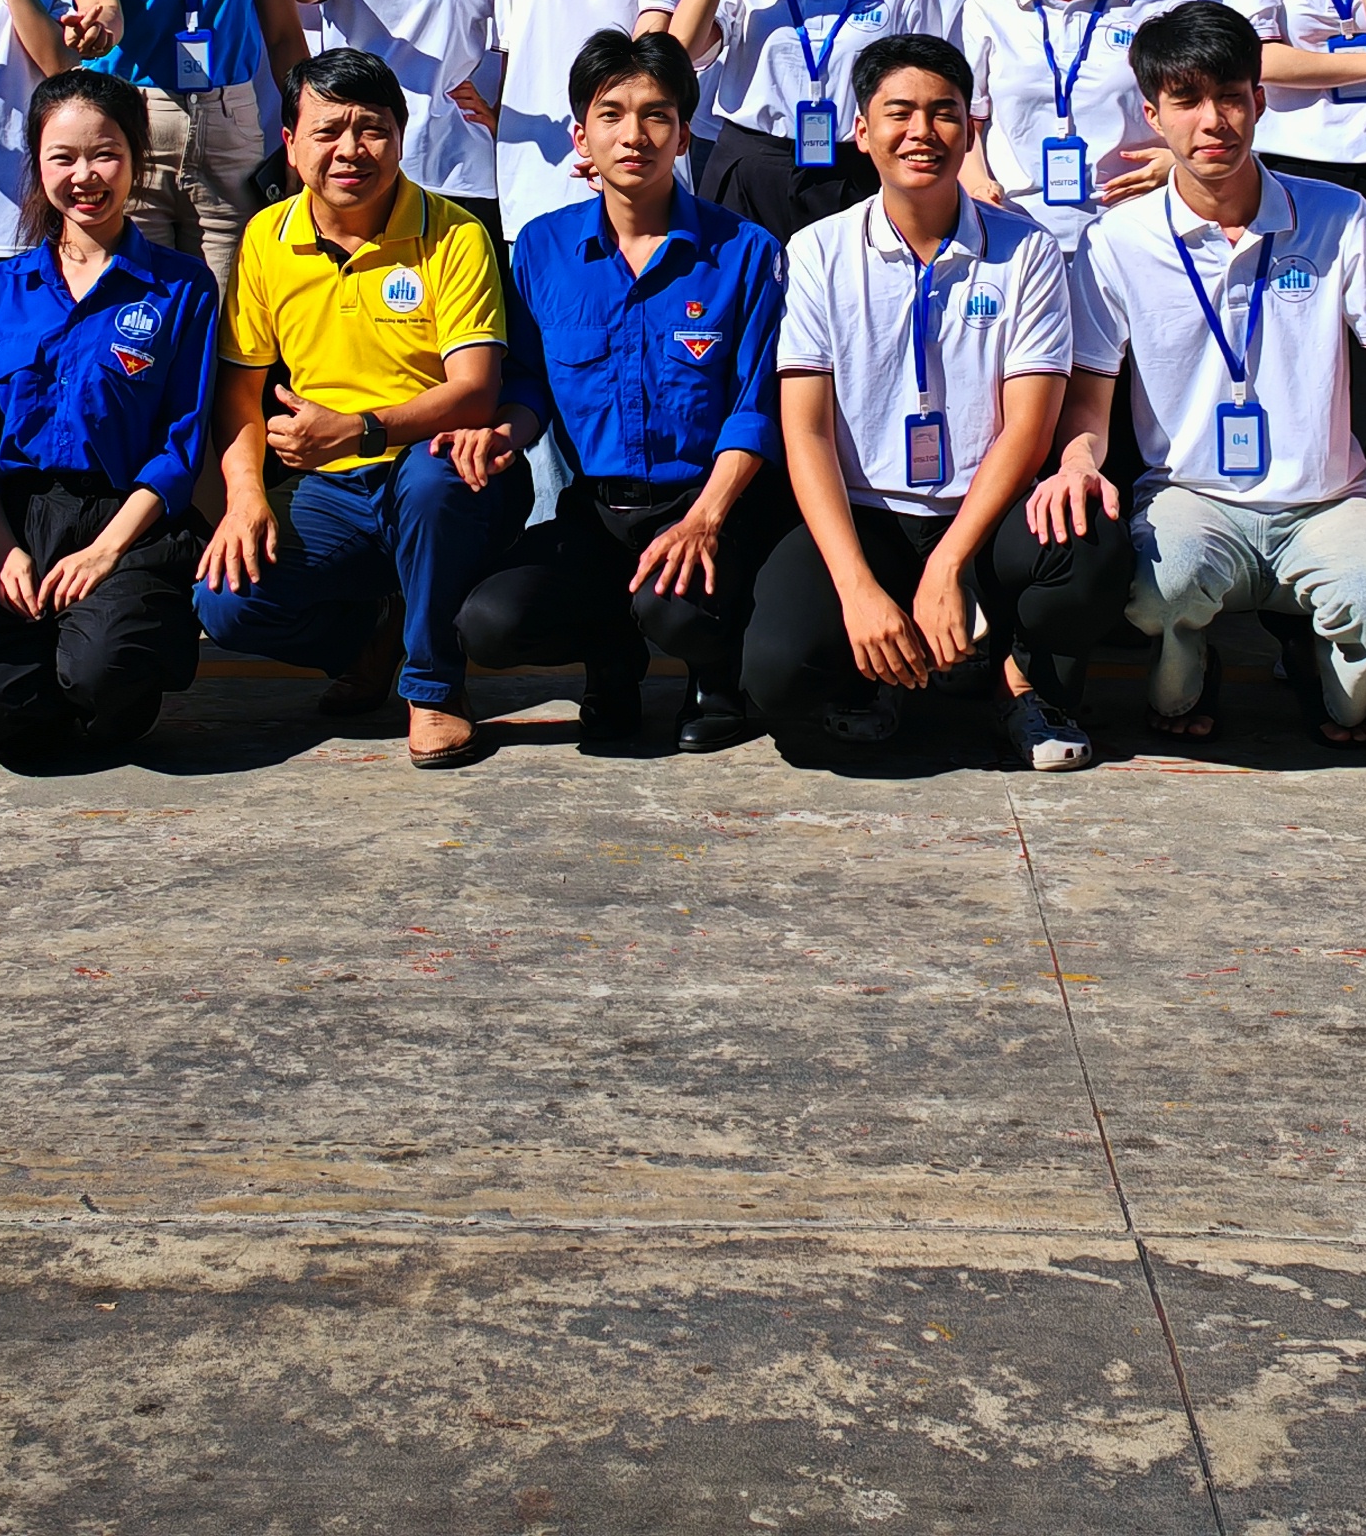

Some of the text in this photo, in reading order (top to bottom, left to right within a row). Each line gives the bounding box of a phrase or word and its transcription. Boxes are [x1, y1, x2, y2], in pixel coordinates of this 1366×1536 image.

[184, 60, 203, 74] 30
[801, 139, 830, 147] VISITOR
[1279, 272, 1310, 289] NTU
[389, 286, 417, 301] NTU
[967, 298, 997, 316] NTU
[1232, 433, 1249, 446] 04
